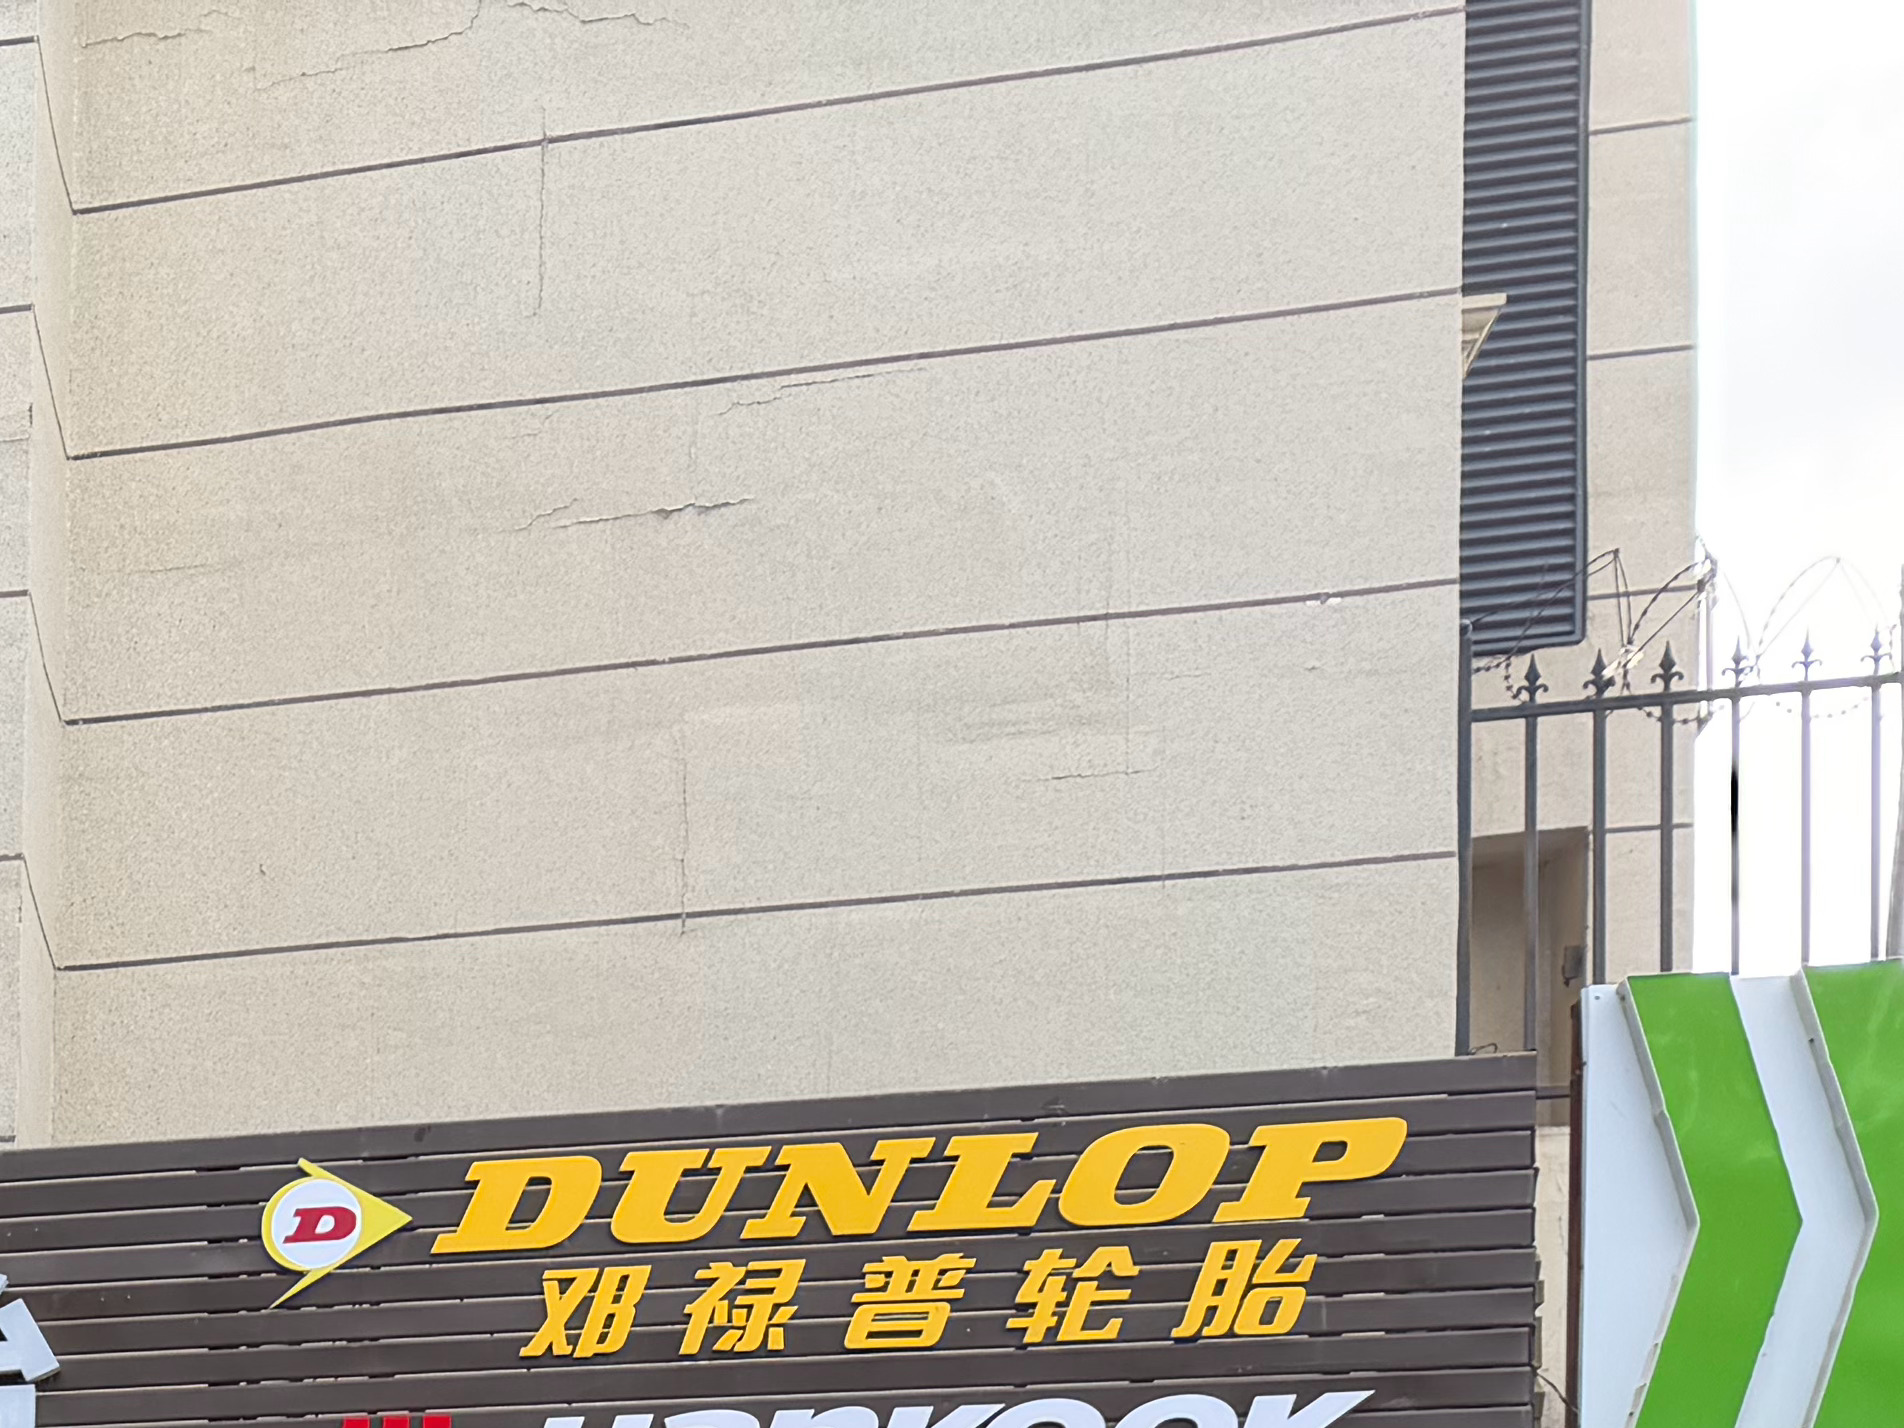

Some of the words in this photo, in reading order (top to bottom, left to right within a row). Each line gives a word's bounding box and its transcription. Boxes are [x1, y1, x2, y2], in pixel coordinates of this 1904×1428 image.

[430, 1115, 1409, 1256] DUNLOP
[519, 1238, 1319, 1359] 邓禄普轮胎
